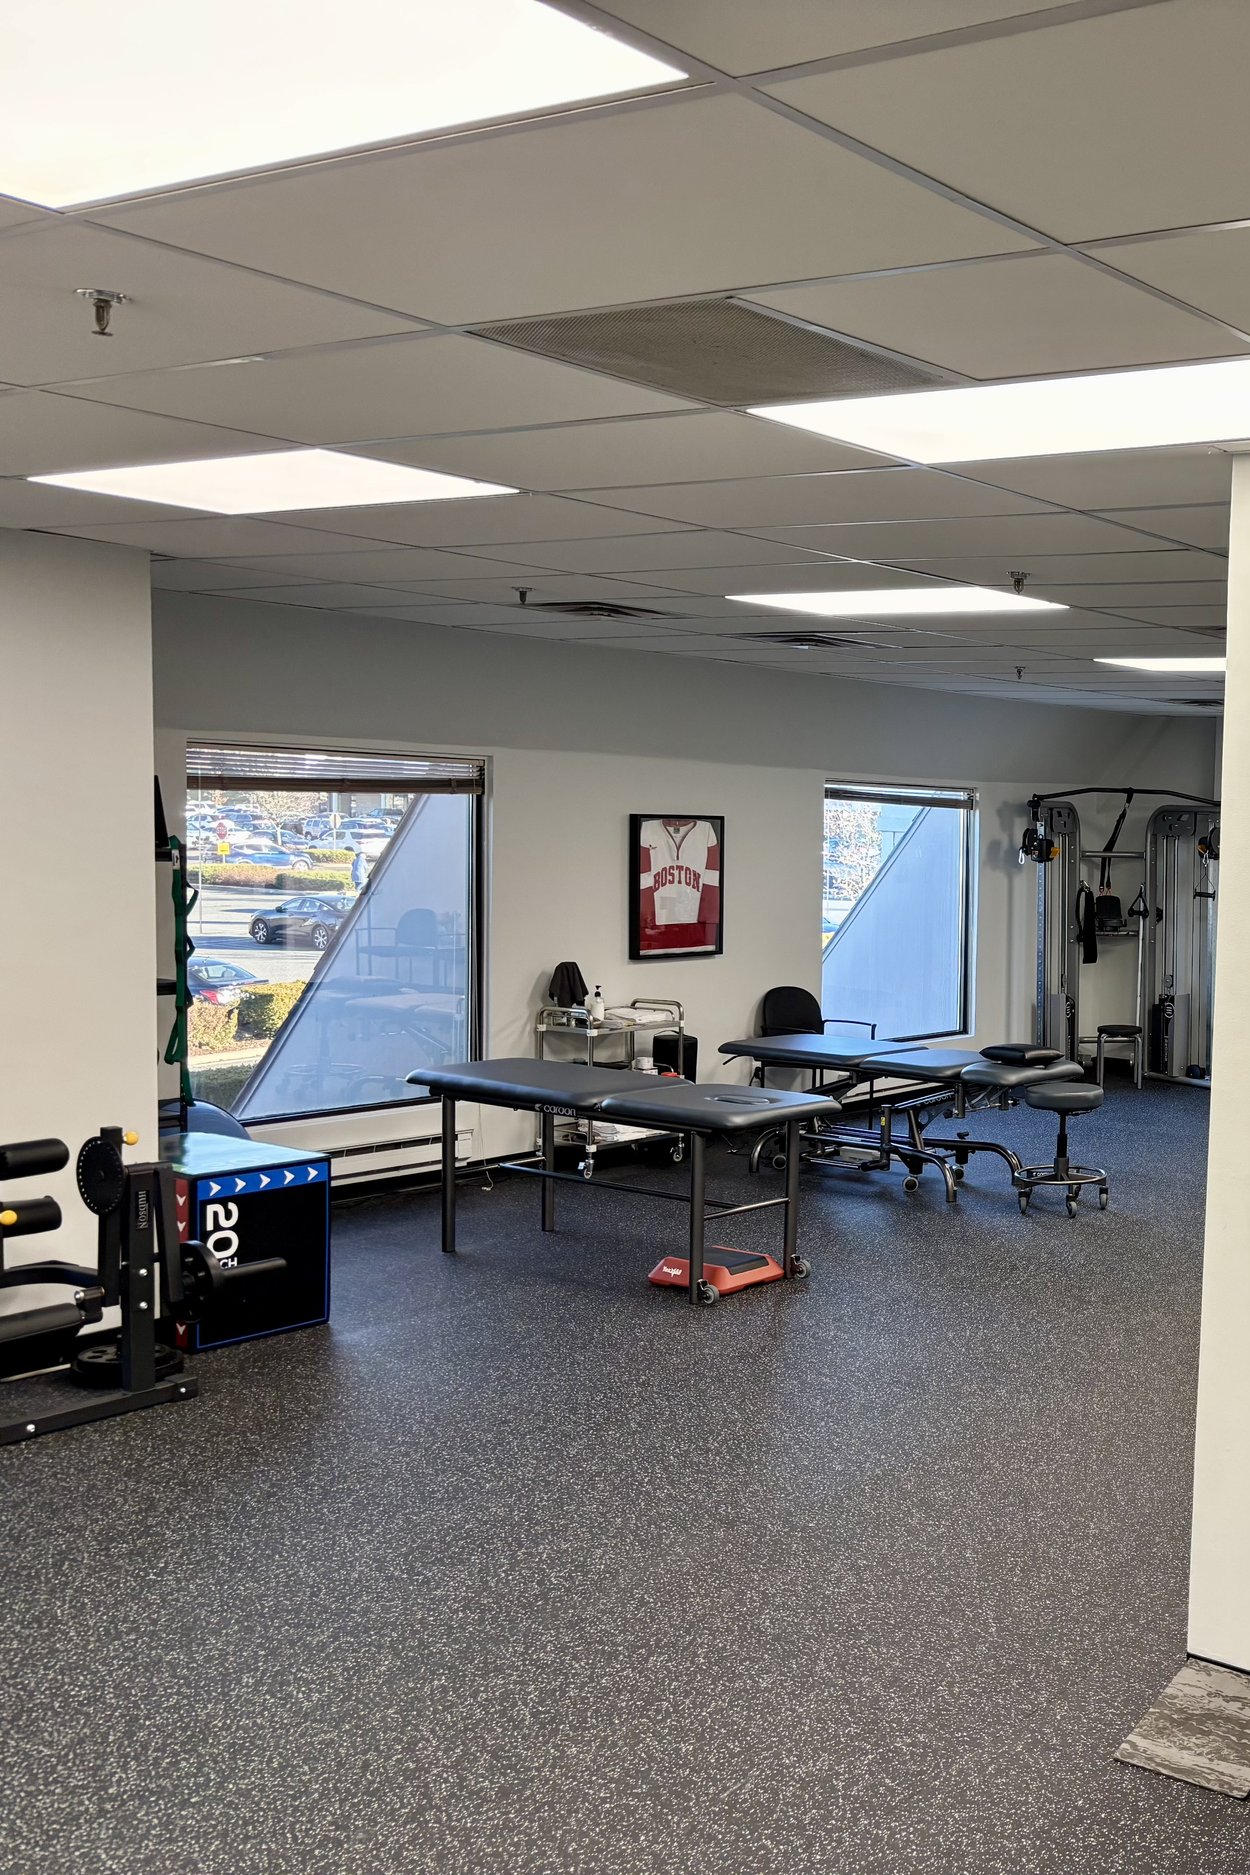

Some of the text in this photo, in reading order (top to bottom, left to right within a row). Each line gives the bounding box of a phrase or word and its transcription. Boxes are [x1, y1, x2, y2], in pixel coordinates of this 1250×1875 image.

[653, 864, 702, 893] BOSTON
[137, 1190, 148, 1229] HUDSON
[206, 1201, 239, 1259] 20
[220, 1257, 238, 1270] CH
